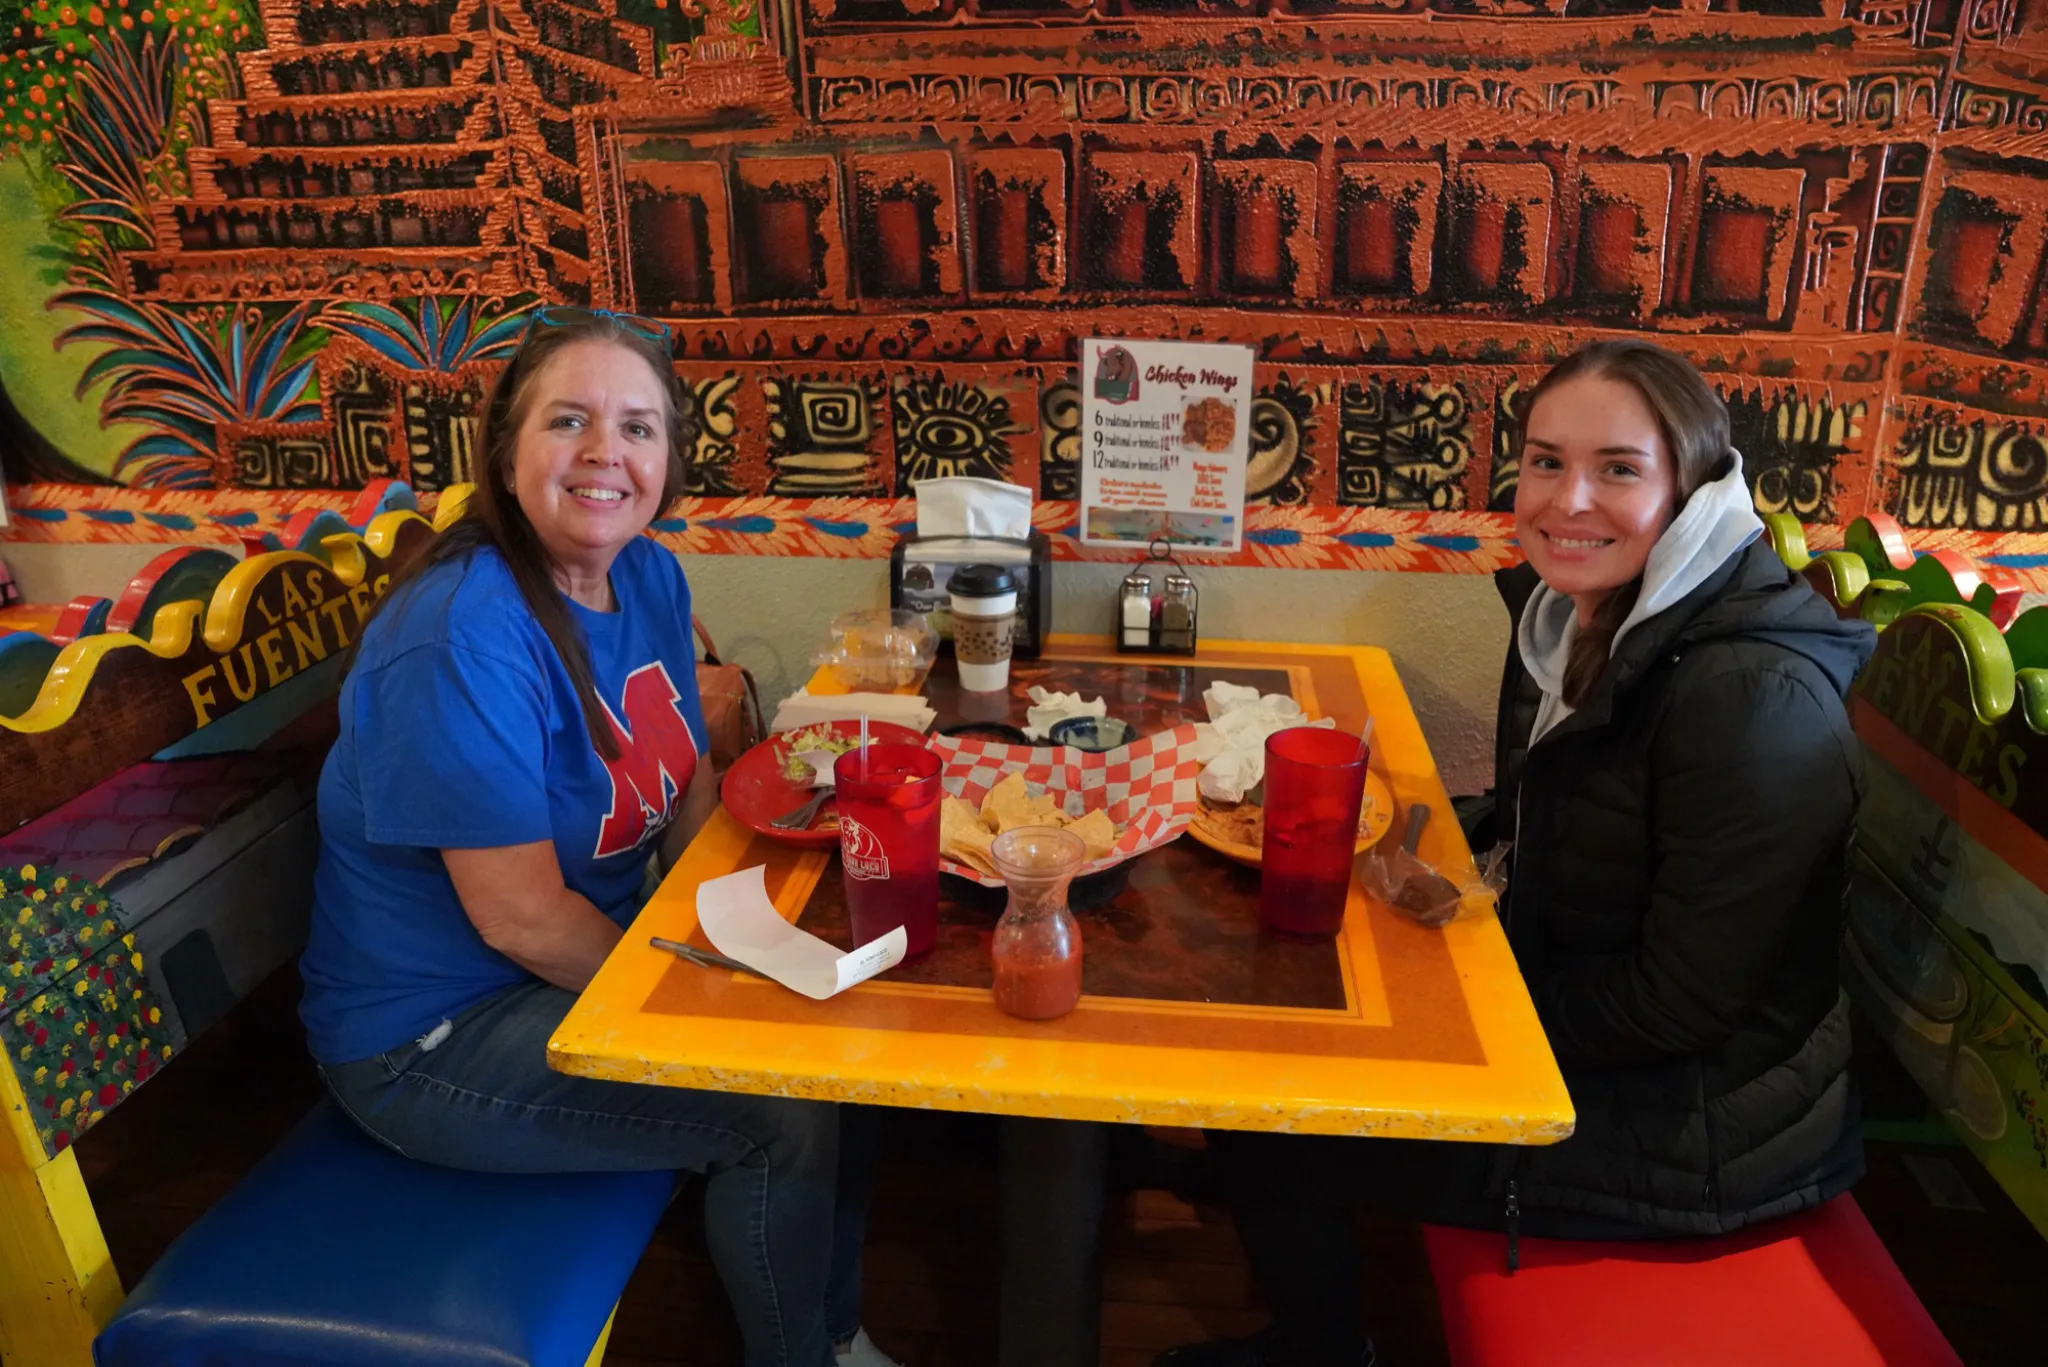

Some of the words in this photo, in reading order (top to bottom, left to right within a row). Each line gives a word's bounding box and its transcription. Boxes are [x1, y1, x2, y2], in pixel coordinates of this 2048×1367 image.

[1145, 364, 1197, 390] Chicken
[1200, 368, 1238, 393] Wings
[1095, 410, 1103, 426] 6
[1094, 431, 1103, 448] 9
[1093, 450, 1104, 469] 12
[255, 569, 325, 626] LAS
[1895, 625, 1958, 695] LAS
[1856, 650, 2029, 809] ENTES
